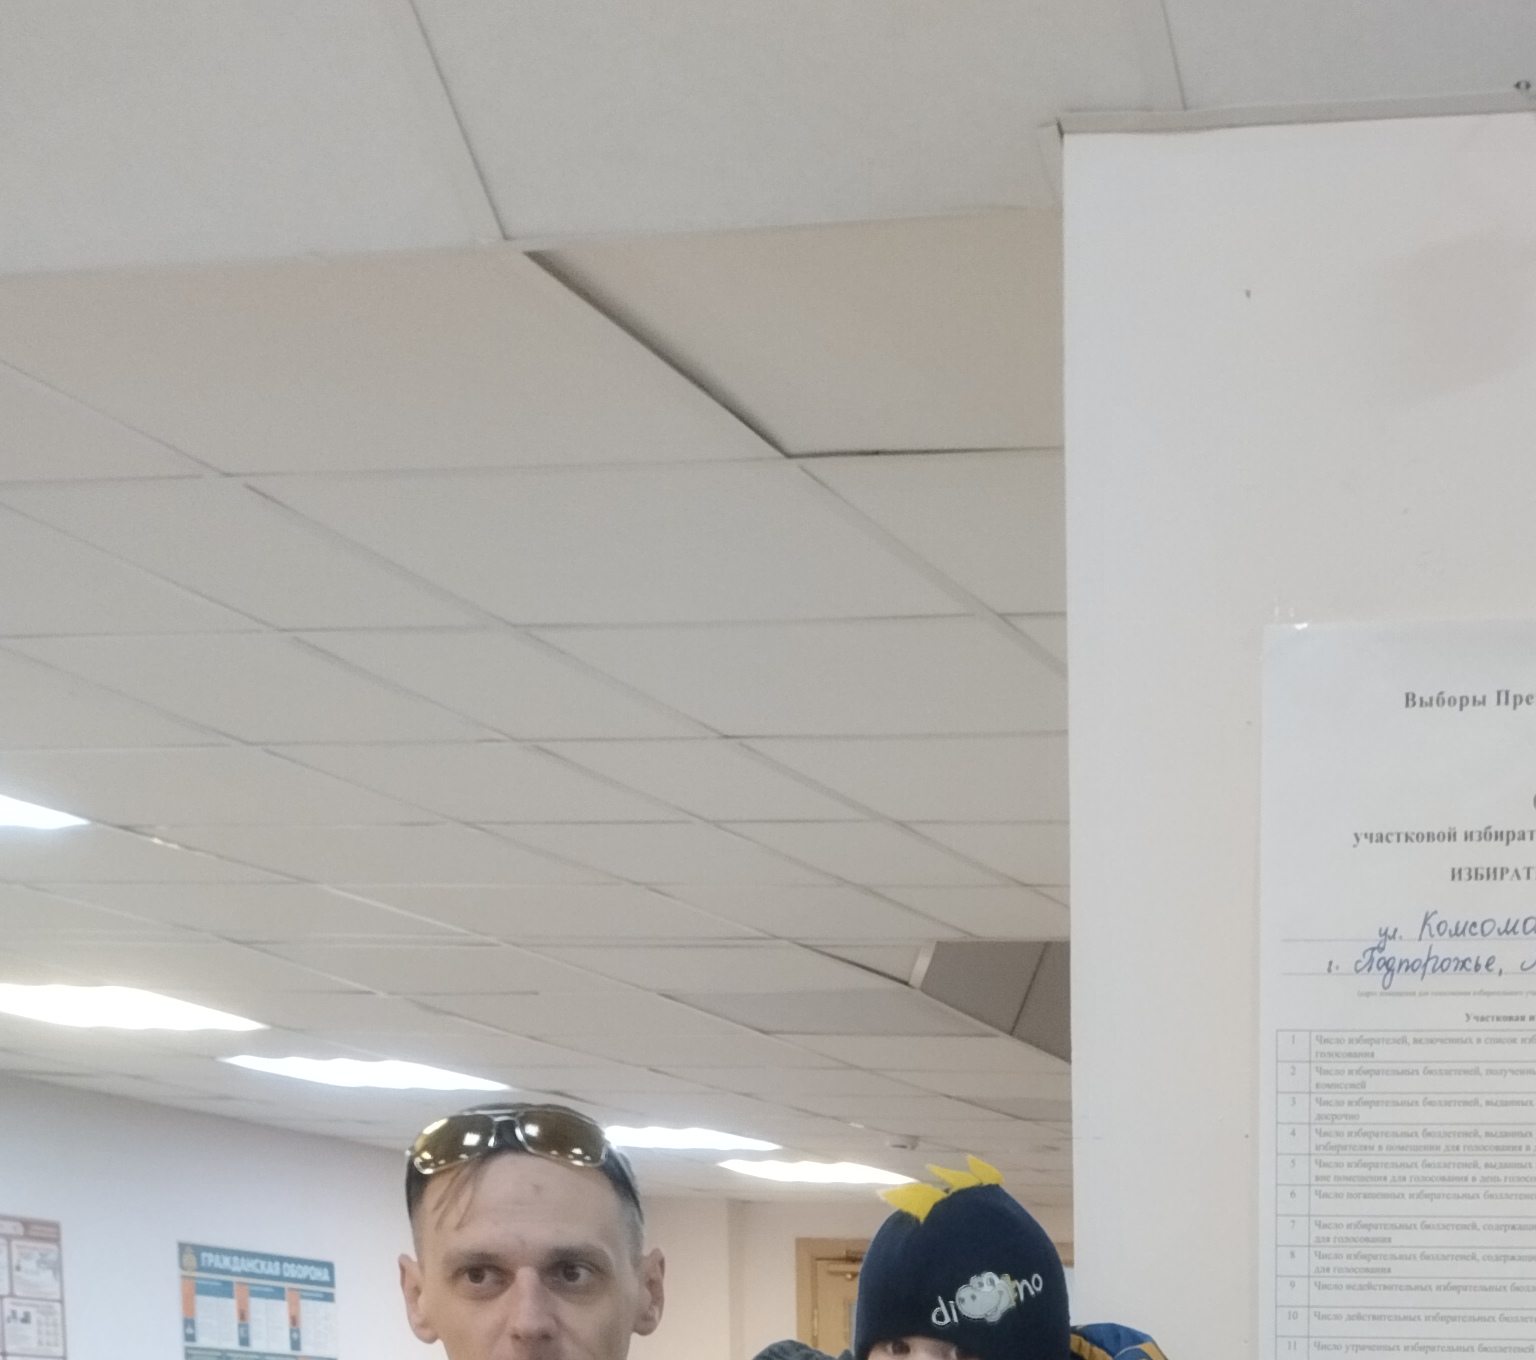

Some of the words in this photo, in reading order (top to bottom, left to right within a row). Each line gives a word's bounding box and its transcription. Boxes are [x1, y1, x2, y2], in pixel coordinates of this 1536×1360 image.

[1403, 688, 1486, 714] Выборы
[1352, 825, 1456, 849] участковой
[1464, 1011, 1525, 1021] Участковая
